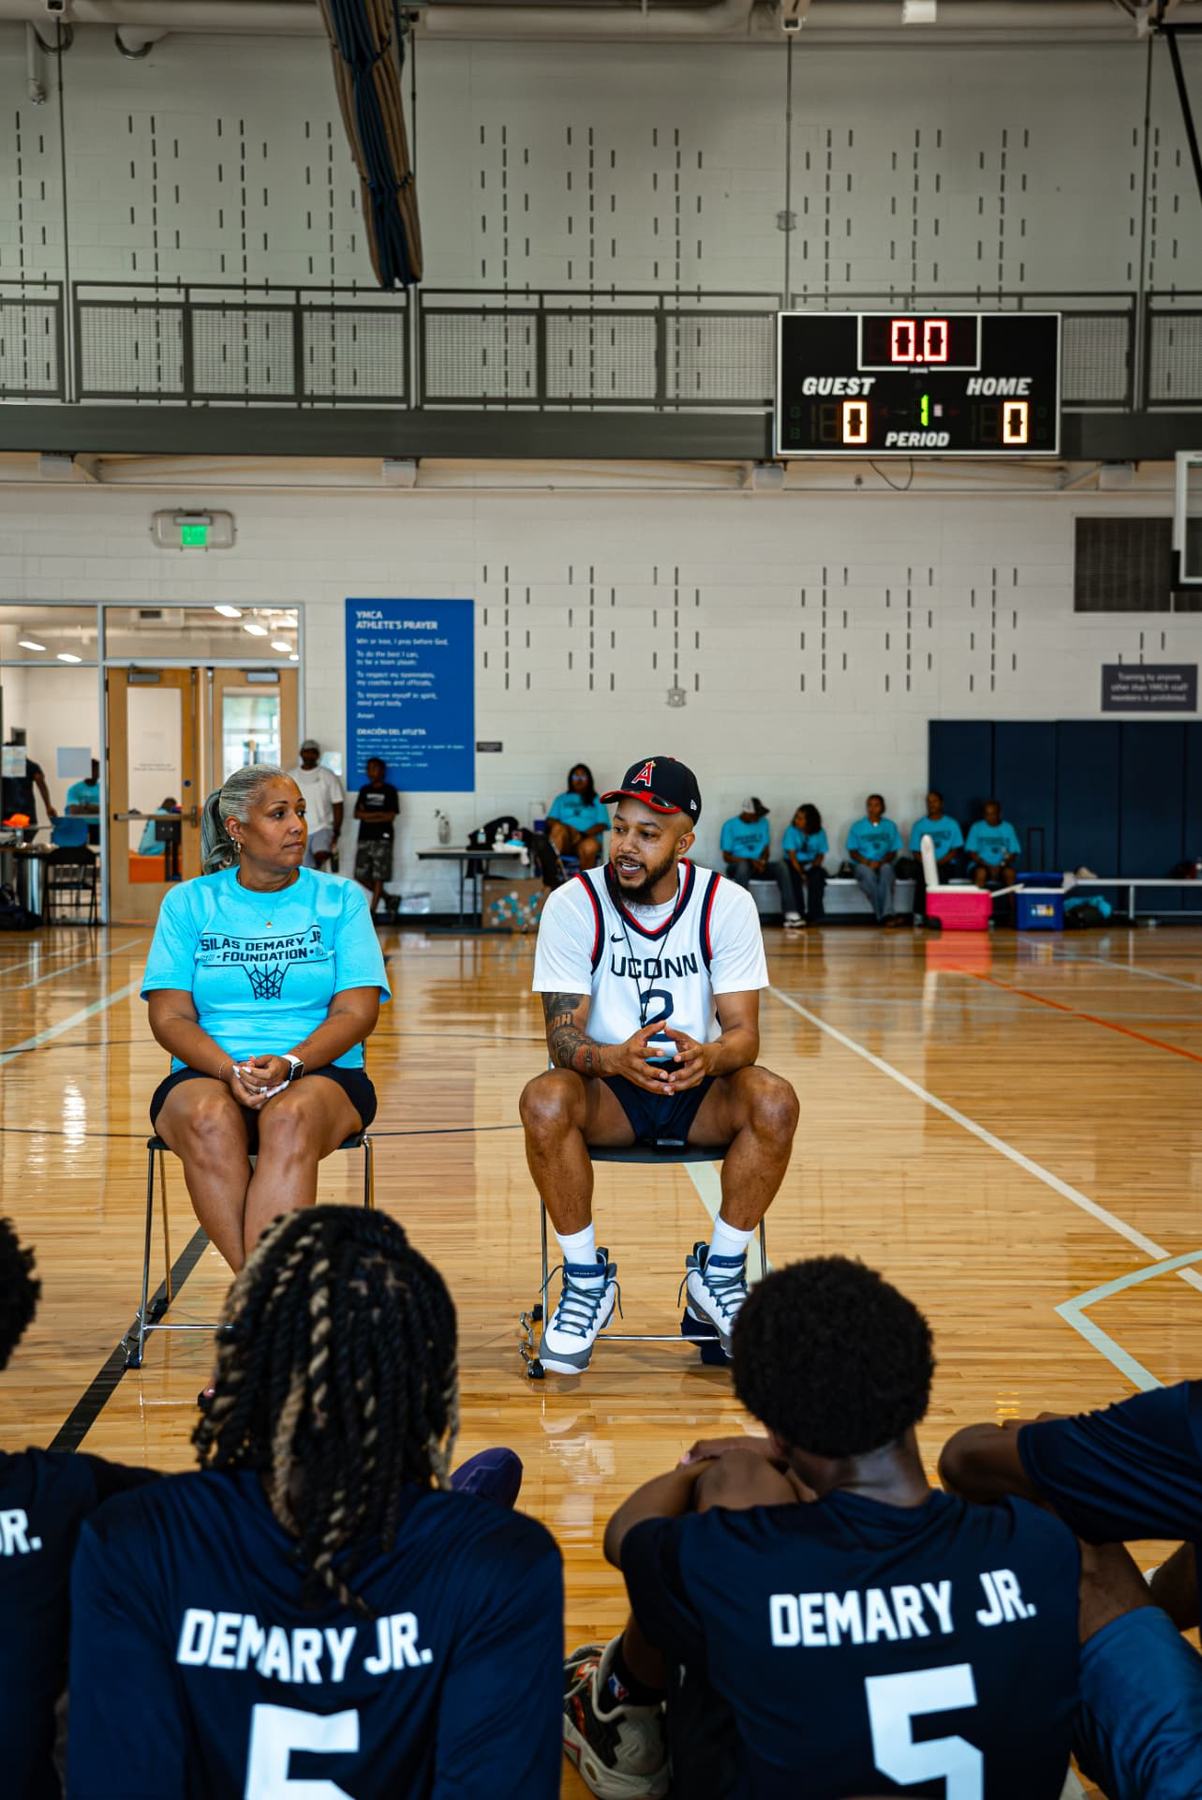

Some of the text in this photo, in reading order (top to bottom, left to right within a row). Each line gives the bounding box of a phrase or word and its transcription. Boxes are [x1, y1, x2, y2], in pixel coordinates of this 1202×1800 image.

[892, 320, 948, 362] 0.0
[802, 377, 876, 396] GUEST
[966, 377, 1033, 396] HOME
[842, 401, 867, 443] 0
[920, 394, 929, 426] 1
[1003, 401, 1028, 443] 0
[885, 431, 950, 447] PERIOD
[356, 610, 383, 619] YMCA
[356, 620, 438, 631] ATHLETE'S PRAYER
[200, 938, 241, 951] SILAS
[245, 937, 305, 952] DEMARY
[222, 947, 308, 962] FOUNDATION
[610, 952, 699, 979] UCONN
[769, 1568, 1037, 1647] DEMARY JR.
[176, 1607, 433, 1684] DEMARY JR.
[863, 1662, 984, 1800] 5
